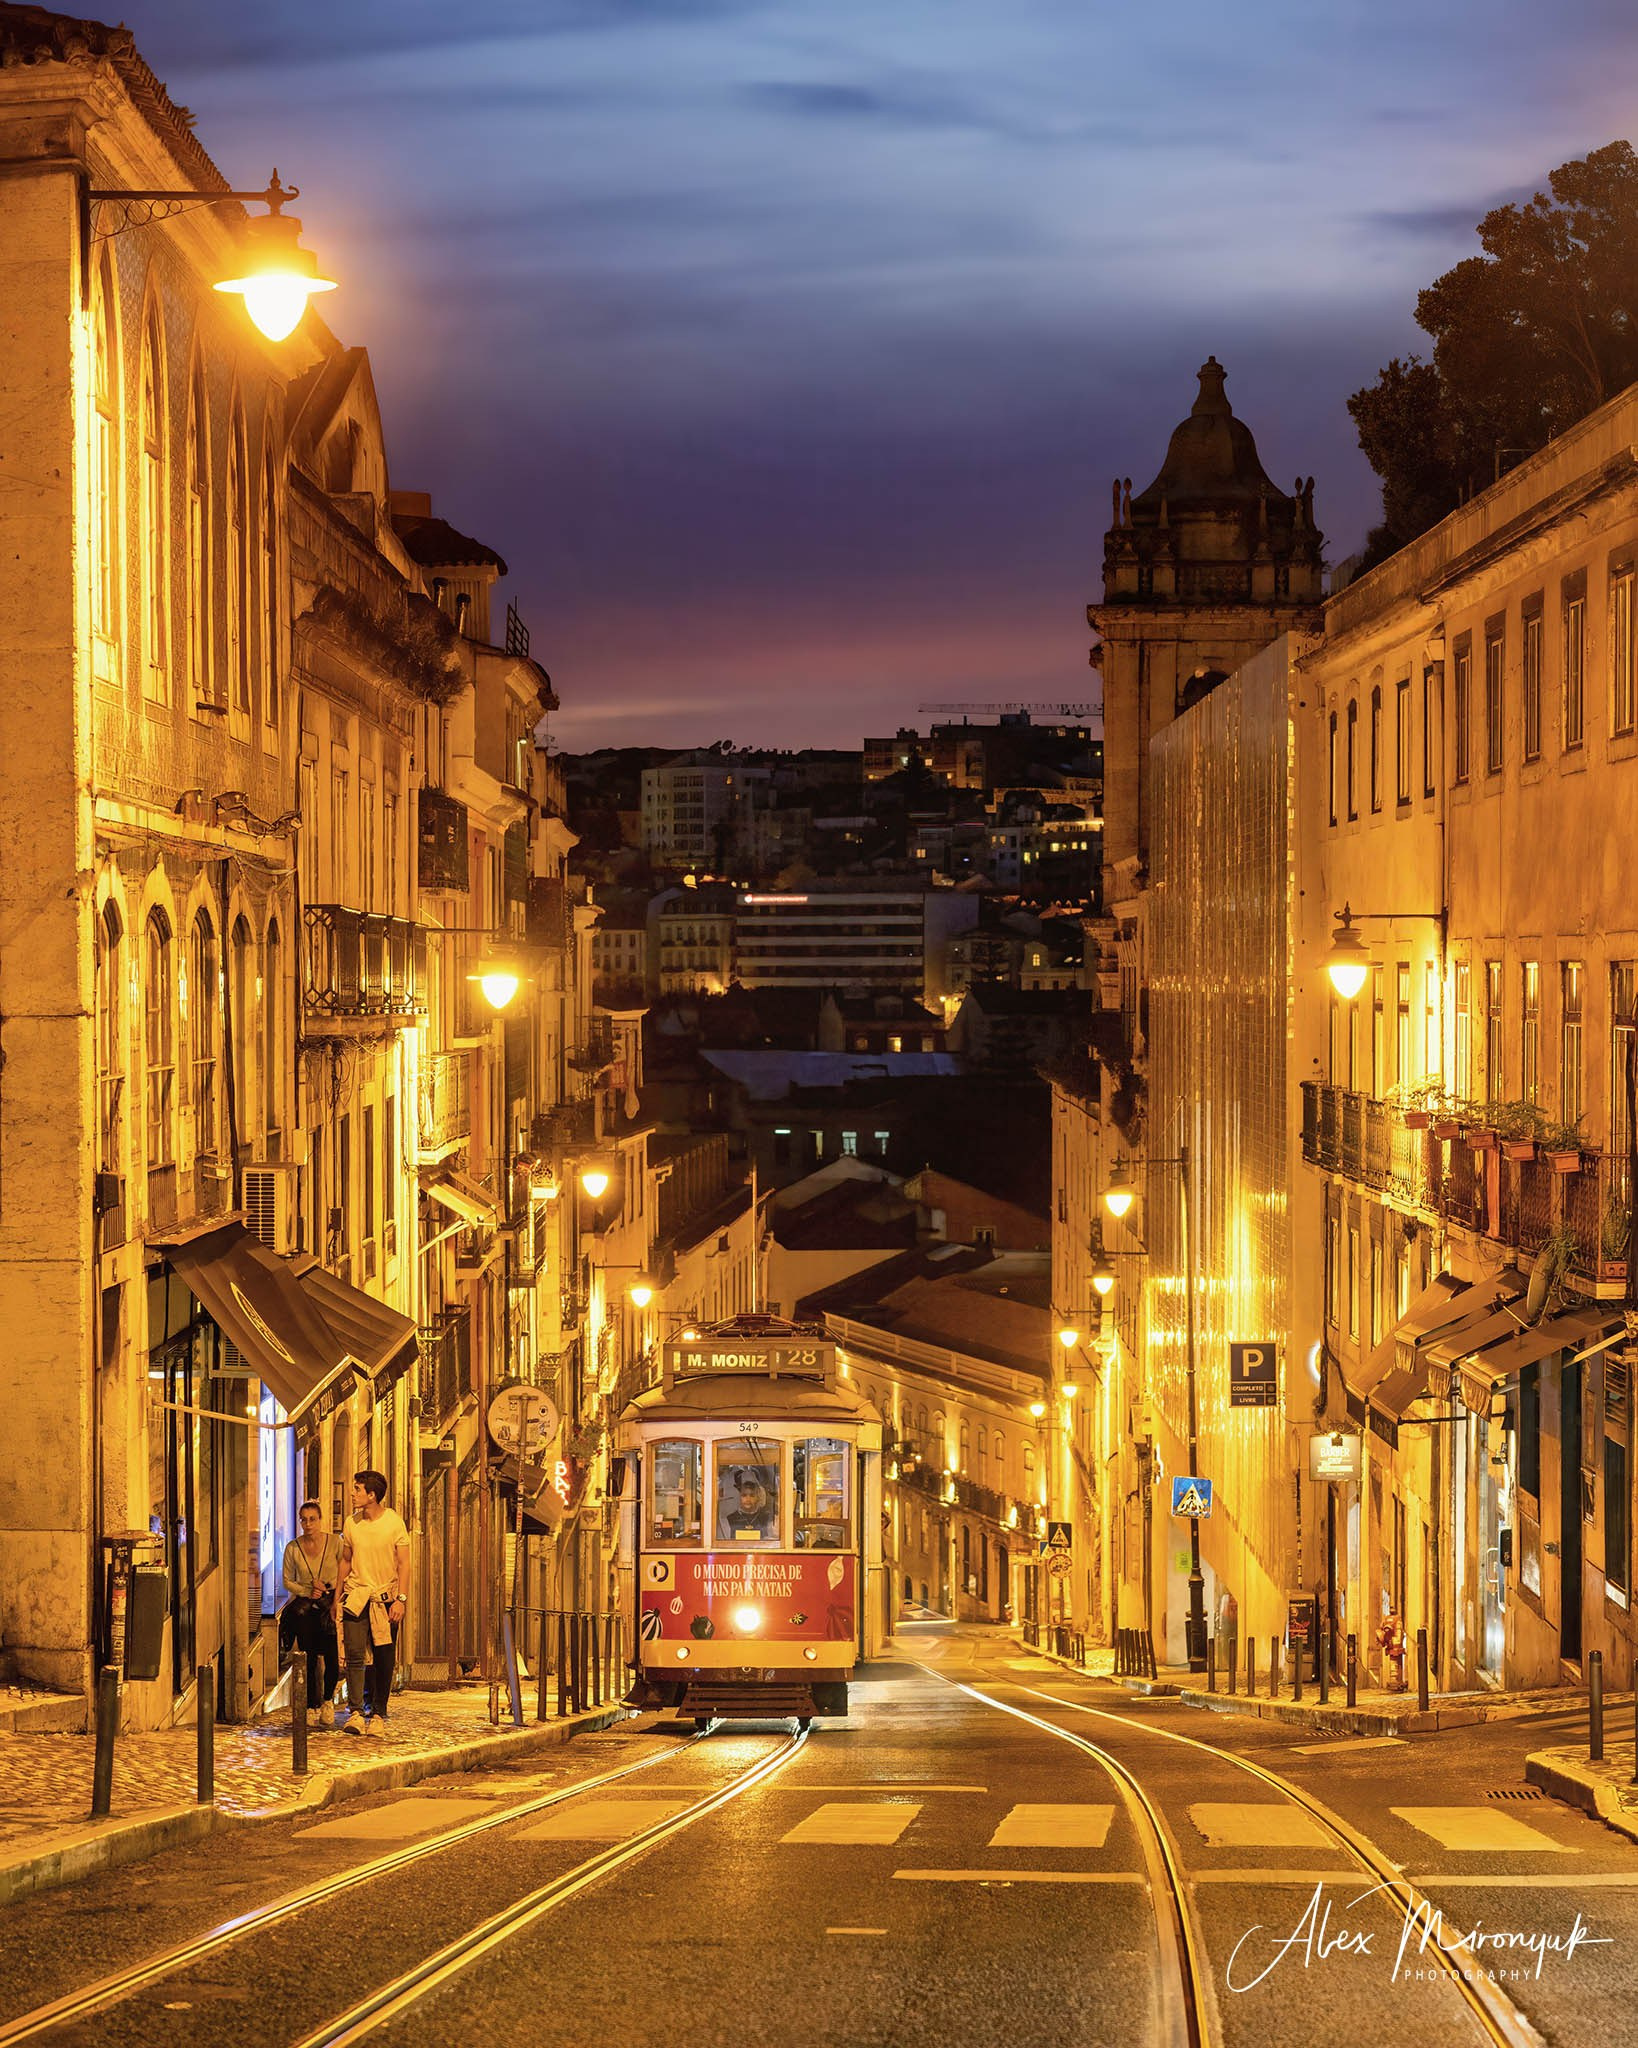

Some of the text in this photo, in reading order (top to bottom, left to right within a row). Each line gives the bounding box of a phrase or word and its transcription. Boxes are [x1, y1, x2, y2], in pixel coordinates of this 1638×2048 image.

[687, 1354, 768, 1368] M. MONIZ
[787, 1350, 817, 1366] 28
[1242, 1349, 1264, 1377] P
[739, 1423, 759, 1432] 549
[693, 1564, 802, 1580] O MUNDO PRECISA DE
[703, 1581, 793, 1598] MAIS PAIS NATAIS
